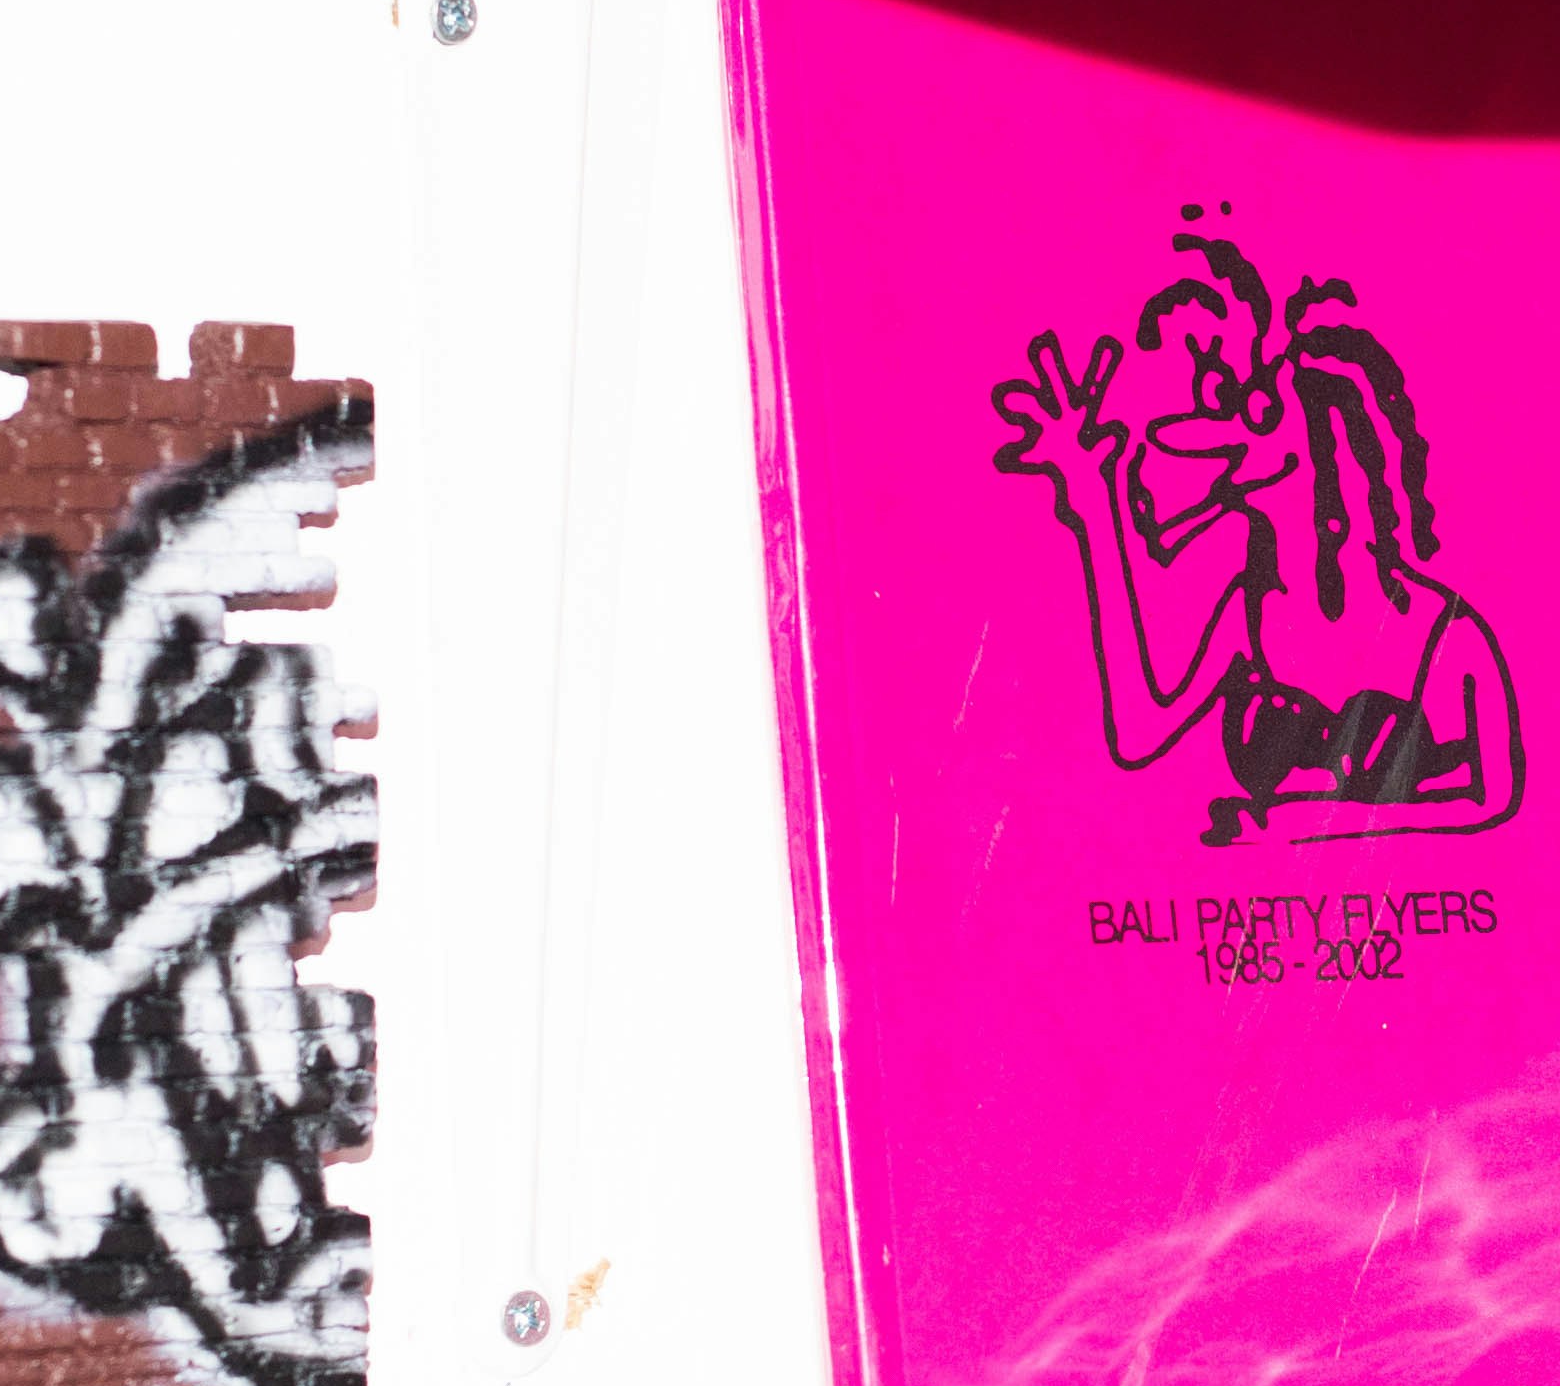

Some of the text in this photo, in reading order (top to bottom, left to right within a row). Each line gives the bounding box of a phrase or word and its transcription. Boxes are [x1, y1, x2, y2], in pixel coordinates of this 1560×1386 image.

[1088, 889, 1498, 944] BALI PARTY FLYERS
[1196, 939, 1285, 985] 1985
[1314, 937, 1404, 981] 2002
